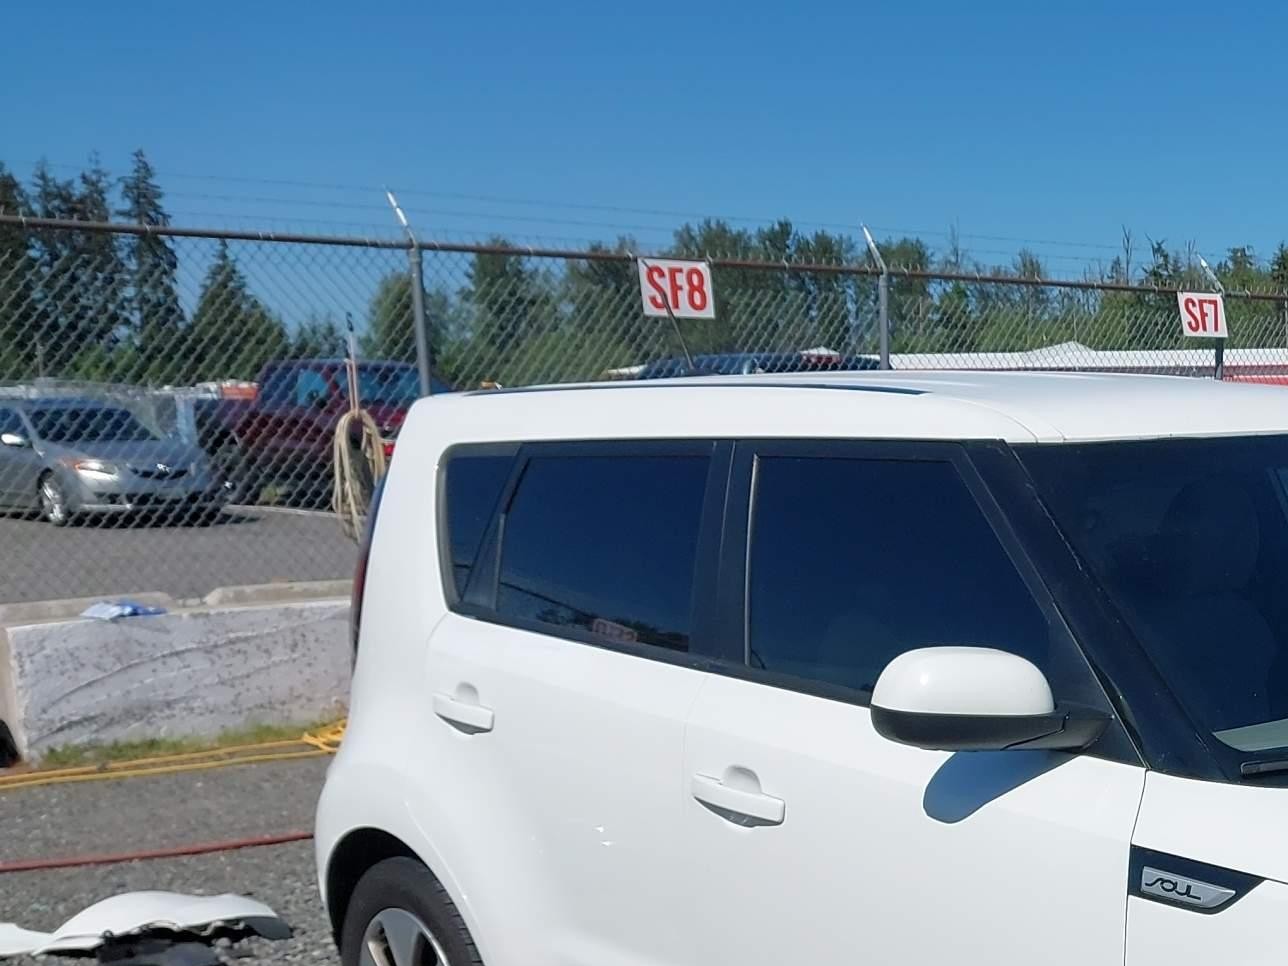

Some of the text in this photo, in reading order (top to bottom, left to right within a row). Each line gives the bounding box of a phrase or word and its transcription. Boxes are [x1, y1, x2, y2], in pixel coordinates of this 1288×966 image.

[646, 265, 707, 311] SF8
[1184, 297, 1219, 332] SF7
[1144, 877, 1202, 901] SOUL
